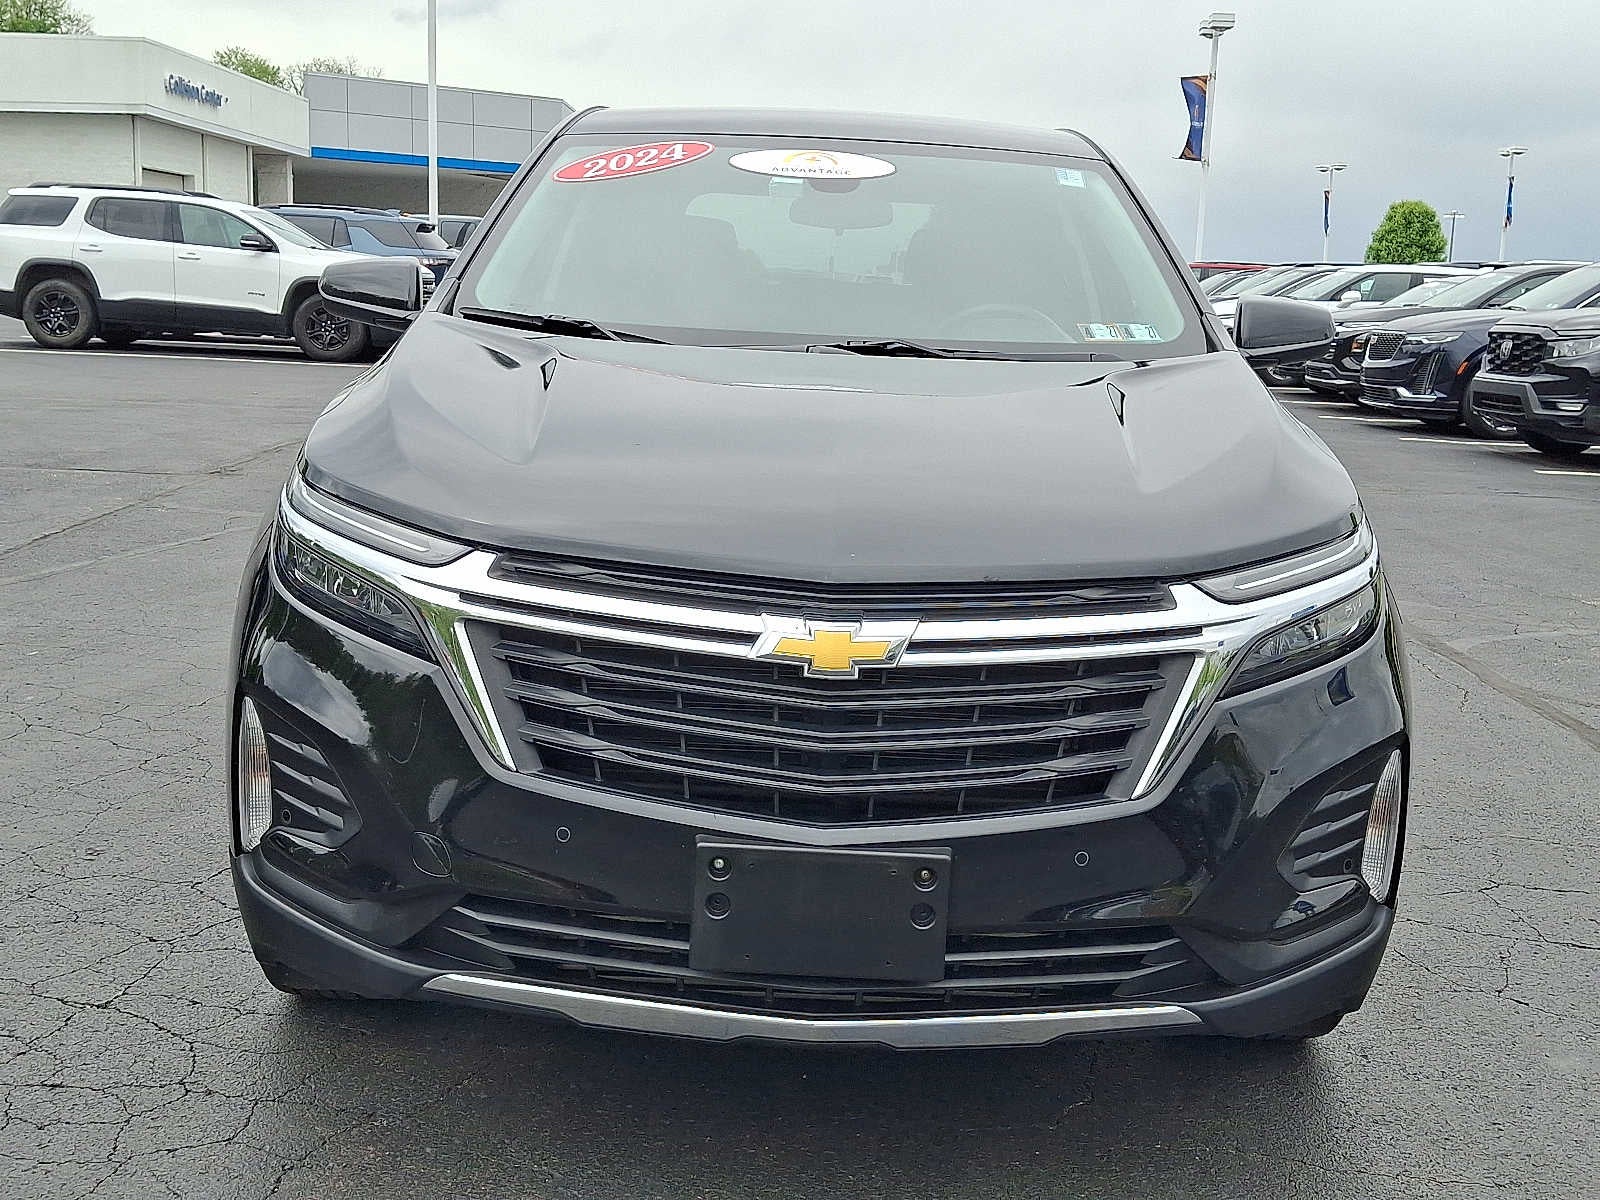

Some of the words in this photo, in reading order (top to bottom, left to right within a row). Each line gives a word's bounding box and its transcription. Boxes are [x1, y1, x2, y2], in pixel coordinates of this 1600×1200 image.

[168, 74, 200, 103] Collision
[200, 84, 222, 107] Center
[583, 143, 688, 178] 2024
[771, 166, 852, 176] ADVANTAGE
